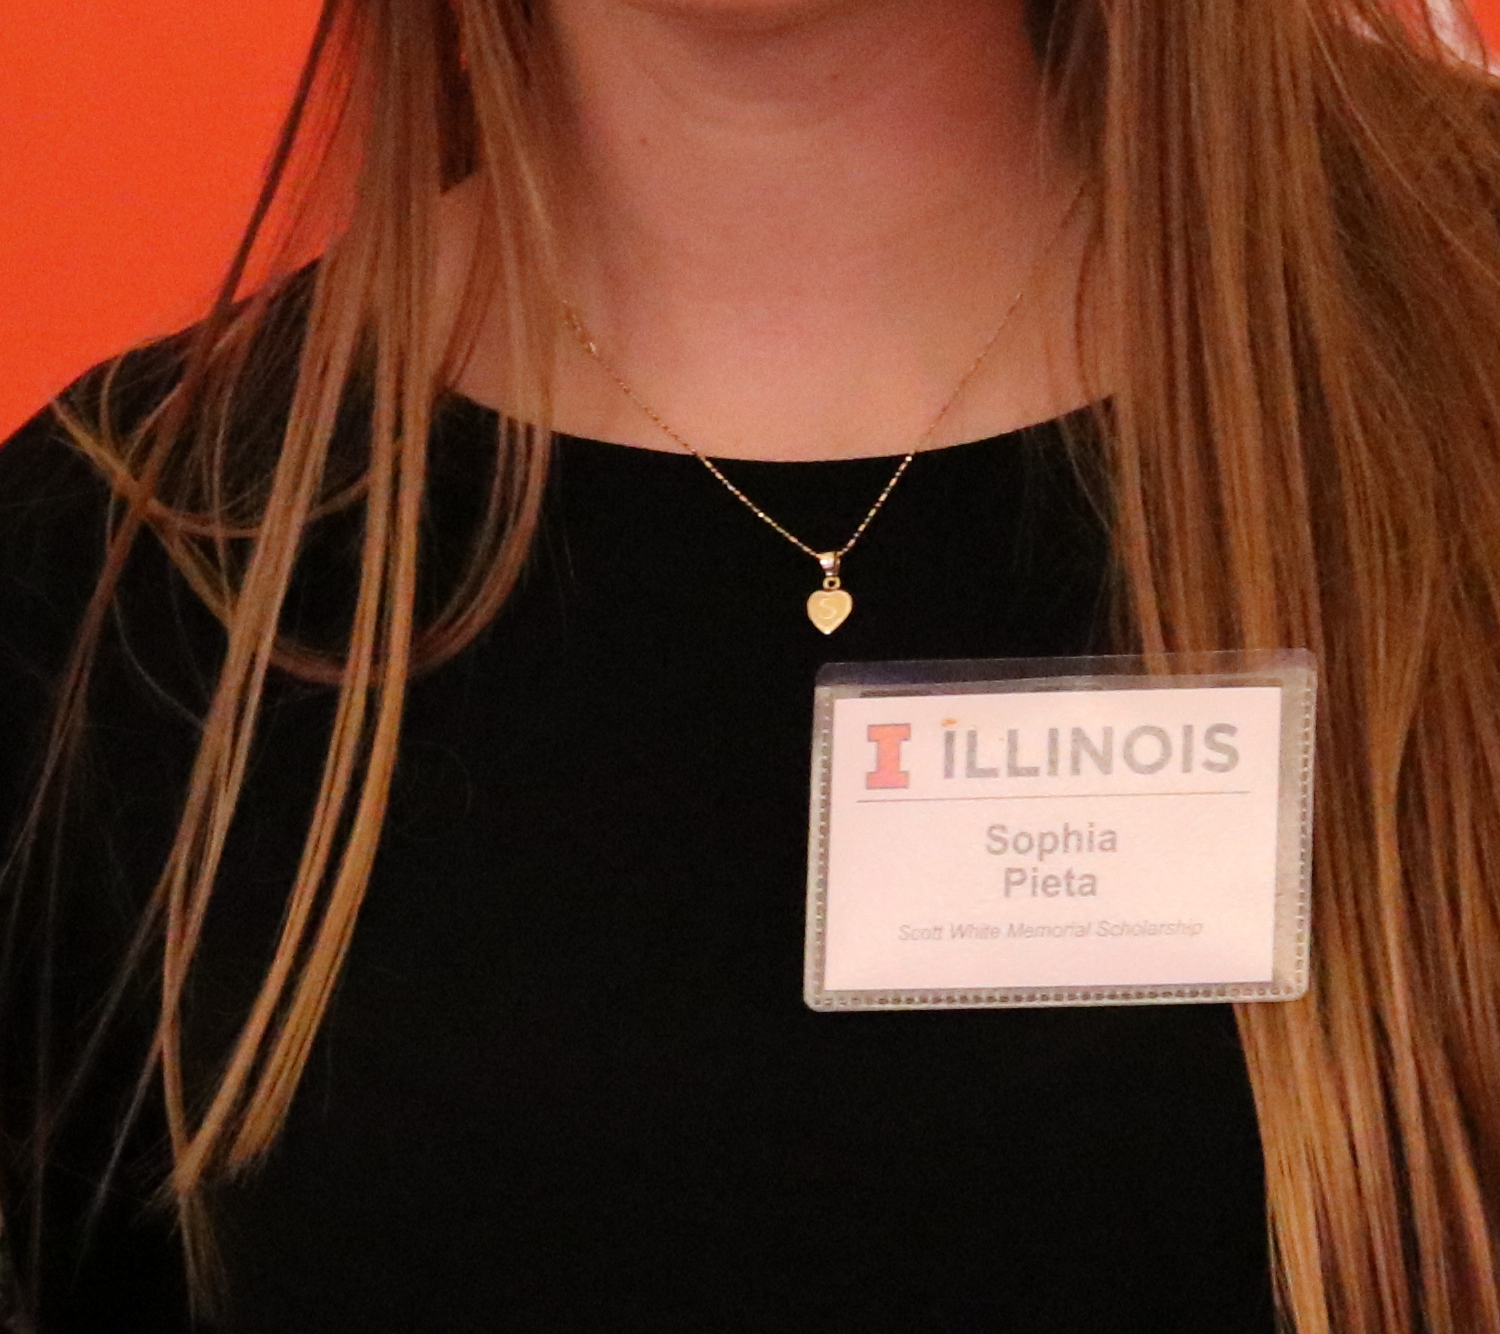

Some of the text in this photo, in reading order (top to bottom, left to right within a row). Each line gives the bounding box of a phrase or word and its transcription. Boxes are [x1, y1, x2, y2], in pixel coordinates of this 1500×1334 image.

[865, 722, 912, 790] I
[942, 722, 1242, 780] ILLINOIS
[985, 822, 1118, 862] Sophia
[1002, 867, 1099, 898] Pieta
[898, 918, 1204, 941] Scott White Memorial Scholarship
